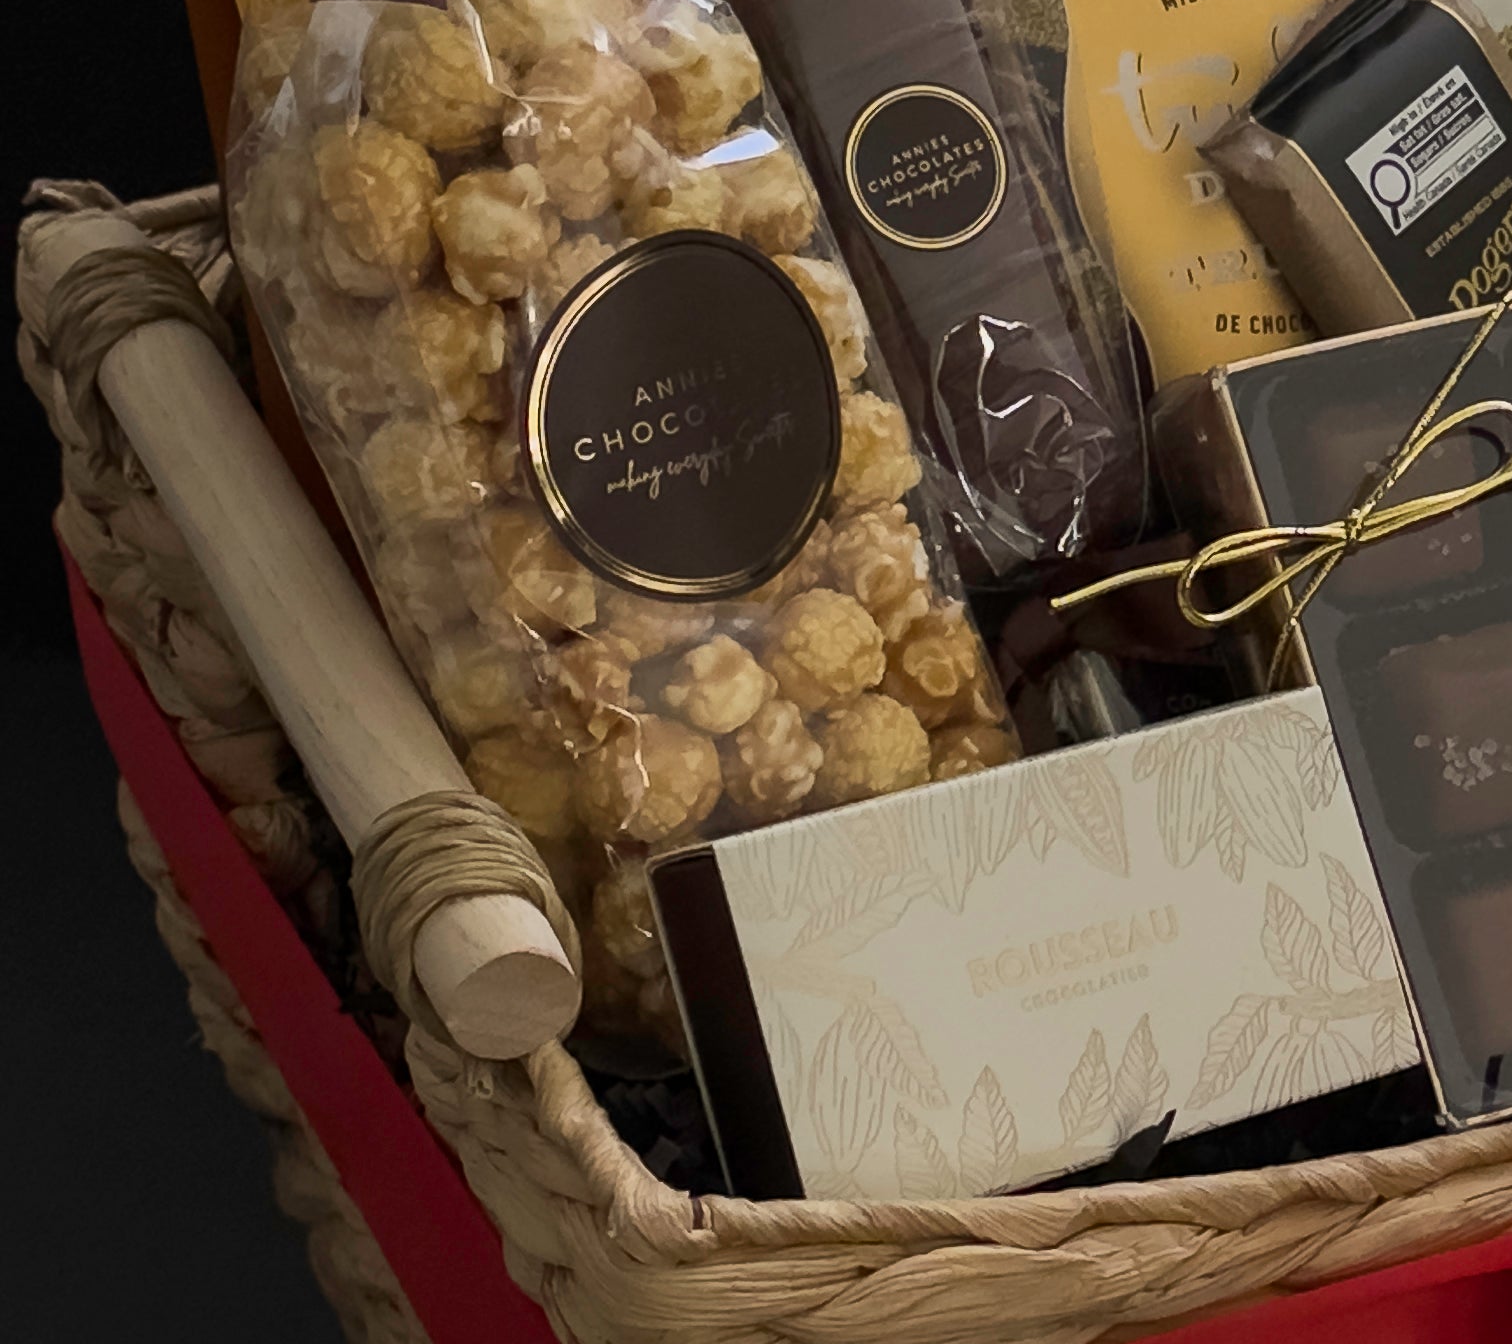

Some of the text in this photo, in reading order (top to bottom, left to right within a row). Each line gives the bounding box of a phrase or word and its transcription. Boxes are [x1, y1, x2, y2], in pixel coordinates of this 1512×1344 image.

[867, 138, 984, 193] CHOCOLATES
[892, 134, 949, 166] ANNIES
[1216, 314, 1240, 333] DE
[635, 358, 730, 406] ANNIE
[967, 904, 1180, 999] ROUSSEAU
